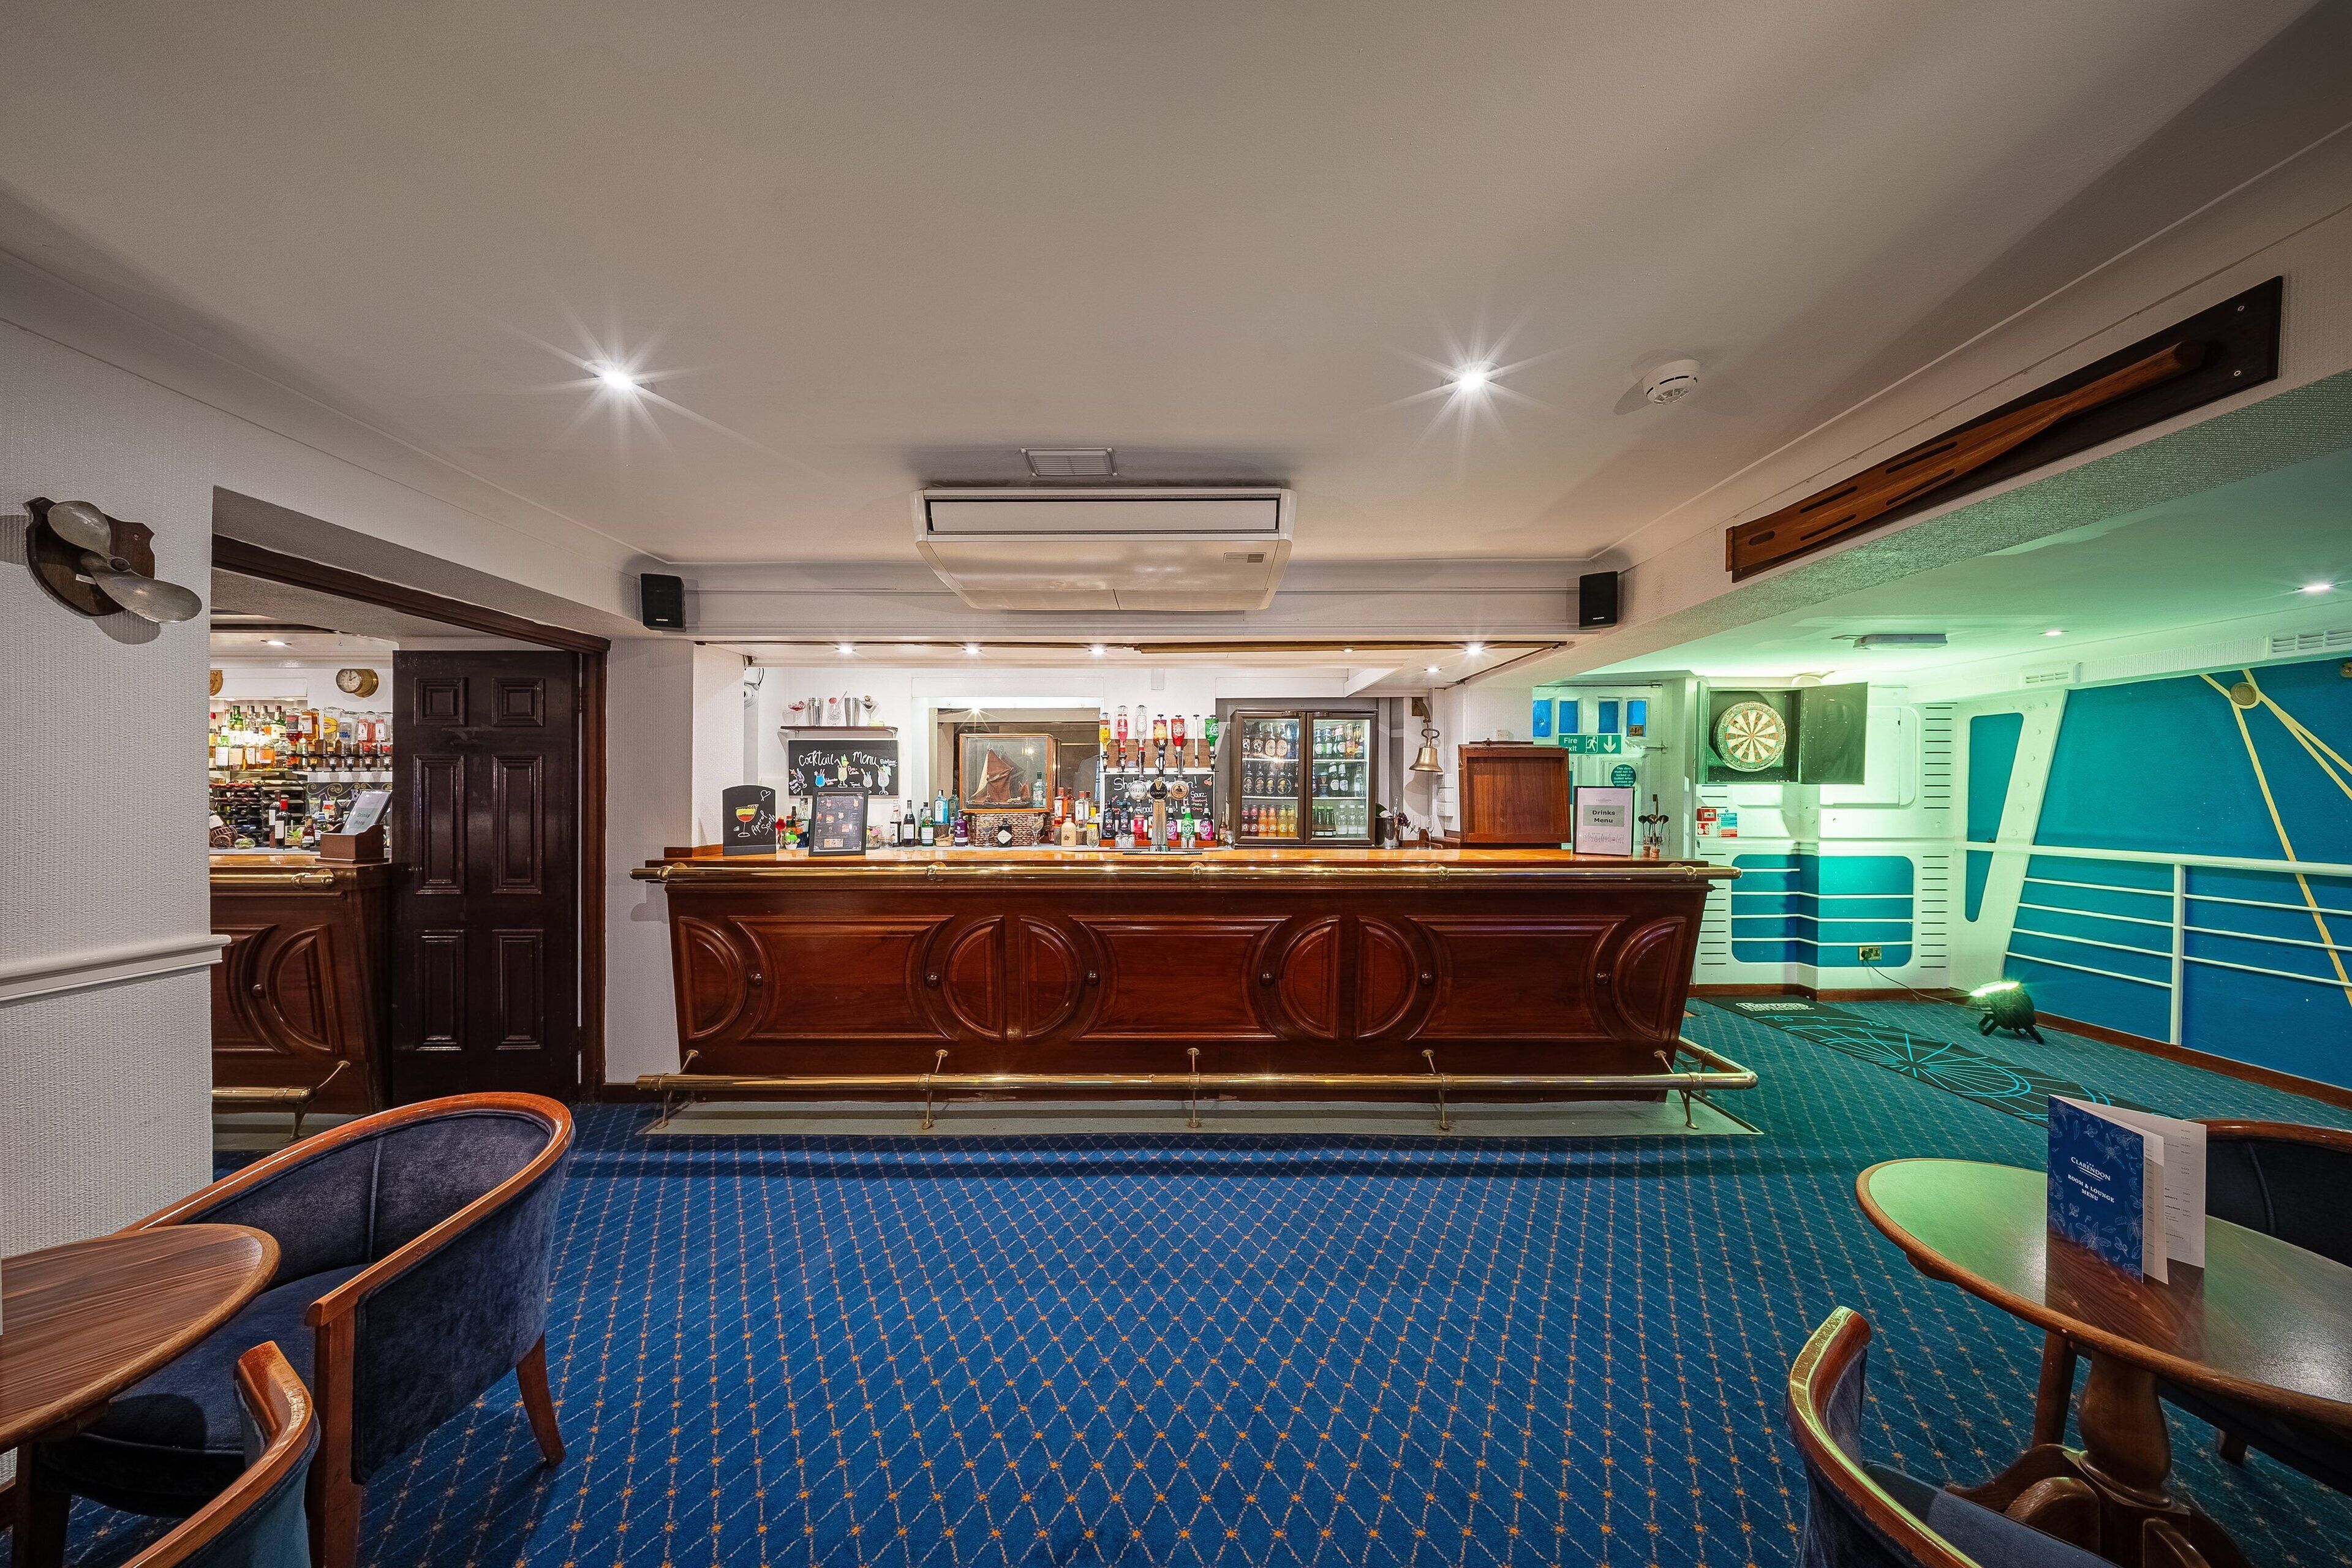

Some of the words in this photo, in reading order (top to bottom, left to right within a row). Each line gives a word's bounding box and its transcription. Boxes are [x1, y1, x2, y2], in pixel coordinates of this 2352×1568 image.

[798, 750, 834, 766] Cocktail
[853, 751, 878, 766] Menu
[751, 810, 768, 836] Aperol
[2071, 1156, 2111, 1181] CLARENDON
[2068, 1174, 2084, 1186] ROOM
[2090, 1186, 2115, 1203] LOUNGE
[2081, 1188, 2098, 1201] MENU
